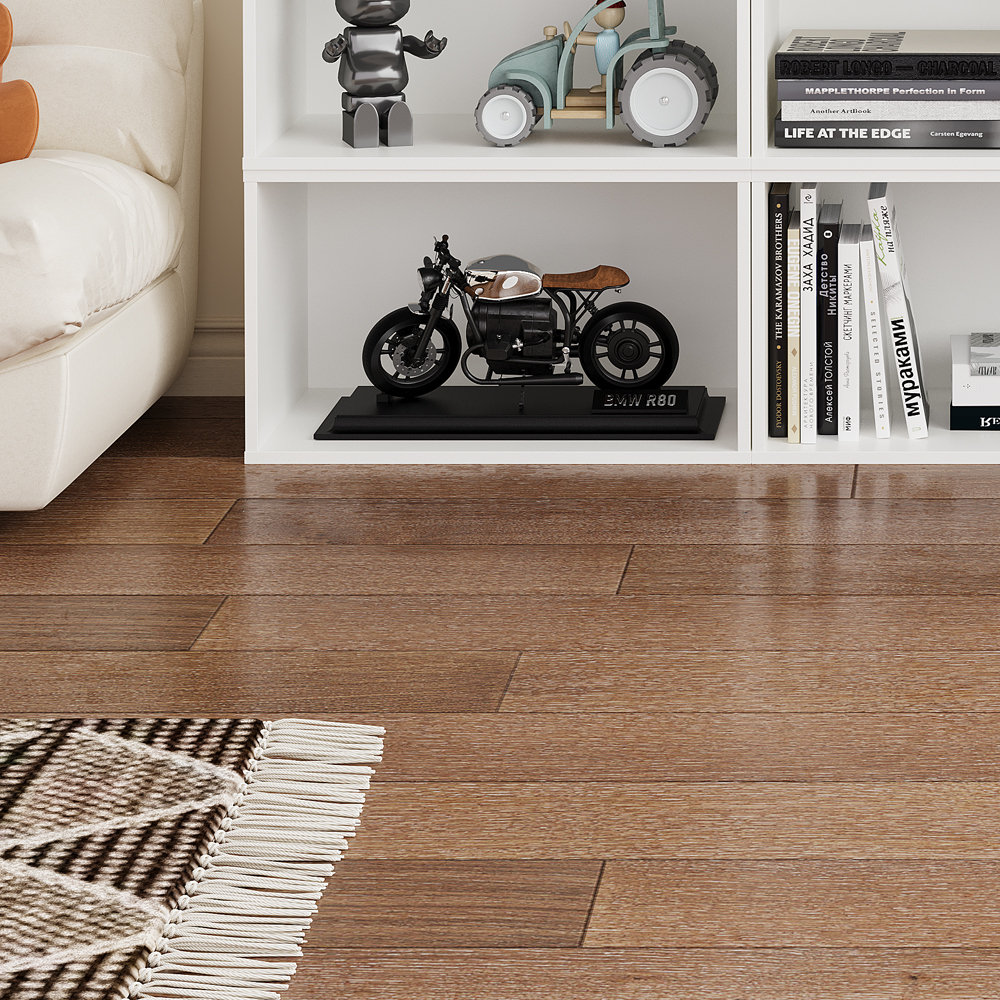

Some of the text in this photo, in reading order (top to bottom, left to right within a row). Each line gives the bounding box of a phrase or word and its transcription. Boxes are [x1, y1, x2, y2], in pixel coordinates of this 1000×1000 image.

[779, 60, 839, 76] ROBERT
[842, 60, 893, 76] LONGO
[917, 60, 997, 76] CHARCOAL
[784, 128, 911, 139] LIFE AT THE EDGE
[881, 205, 895, 253] на пляже
[775, 213, 783, 340] THE KARAMAZOV BROTHERS
[803, 218, 814, 292] ЗАХА ХАДИД
[819, 254, 830, 297] Детство
[787, 238, 800, 338] EUGENE ONEGIN
[828, 275, 837, 316] Никиты
[843, 264, 853, 341] СКЕТЧИНГ МАРКЕРАМИ
[775, 360, 783, 401] DOSTOEVSKY
[824, 342, 833, 423] Алексей ТОЛСТОЙ
[871, 312, 885, 419] SELECTED STORIES
[646, 394, 677, 407] R80
